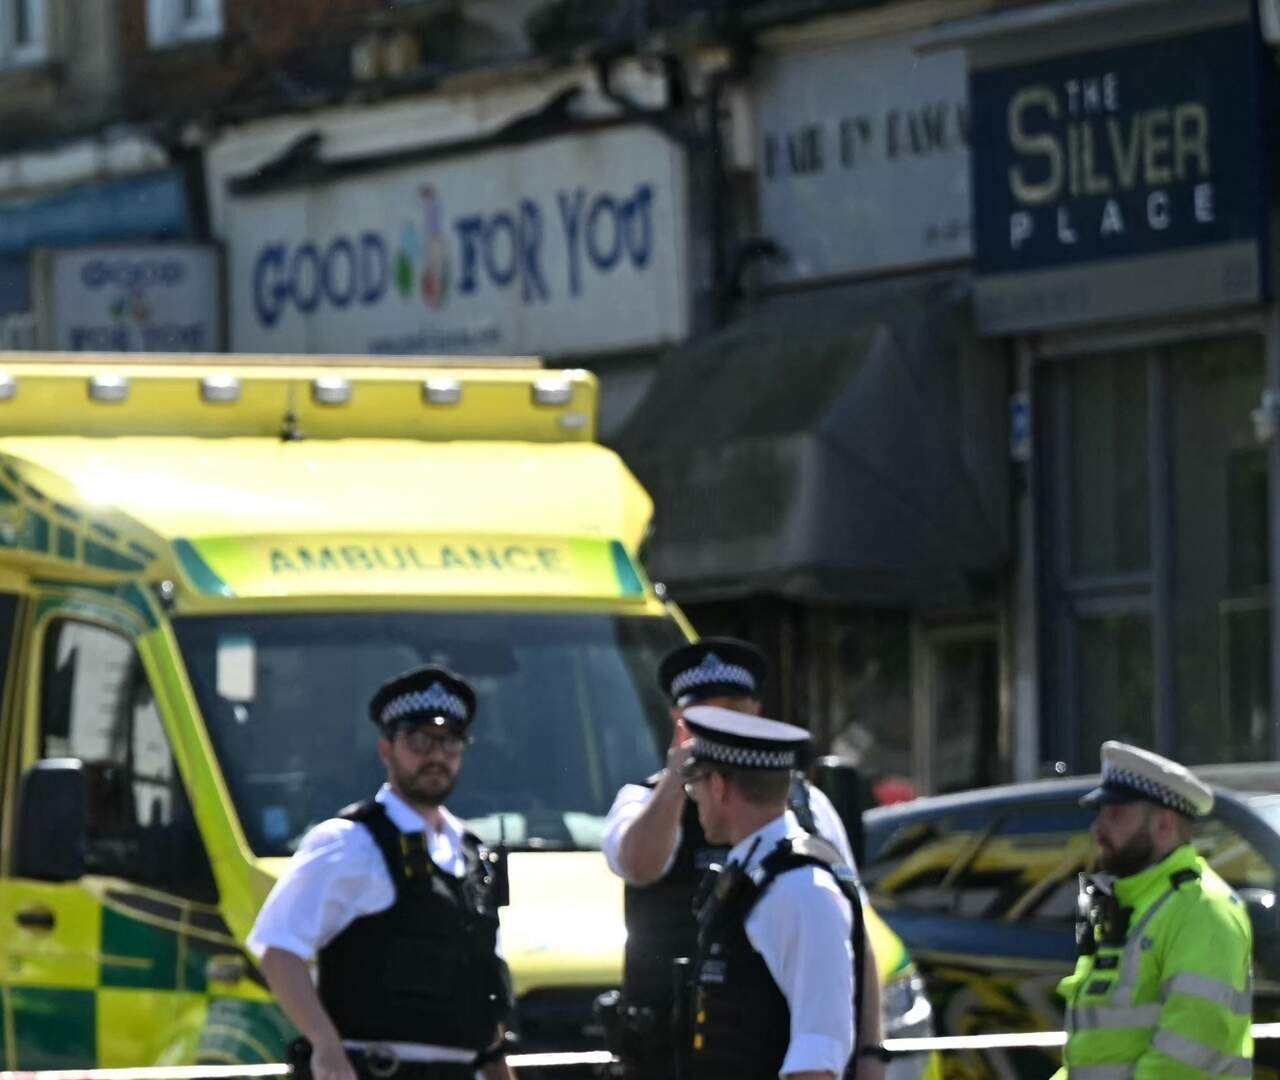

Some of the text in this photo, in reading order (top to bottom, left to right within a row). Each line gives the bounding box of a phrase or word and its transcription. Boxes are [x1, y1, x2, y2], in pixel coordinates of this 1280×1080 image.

[1064, 72, 1118, 116] THE
[1007, 85, 1210, 204] SILVER
[1009, 182, 1216, 251] PLACE
[252, 182, 655, 329] GOOD FOR YOU
[268, 542, 571, 577] AMBULANCE
